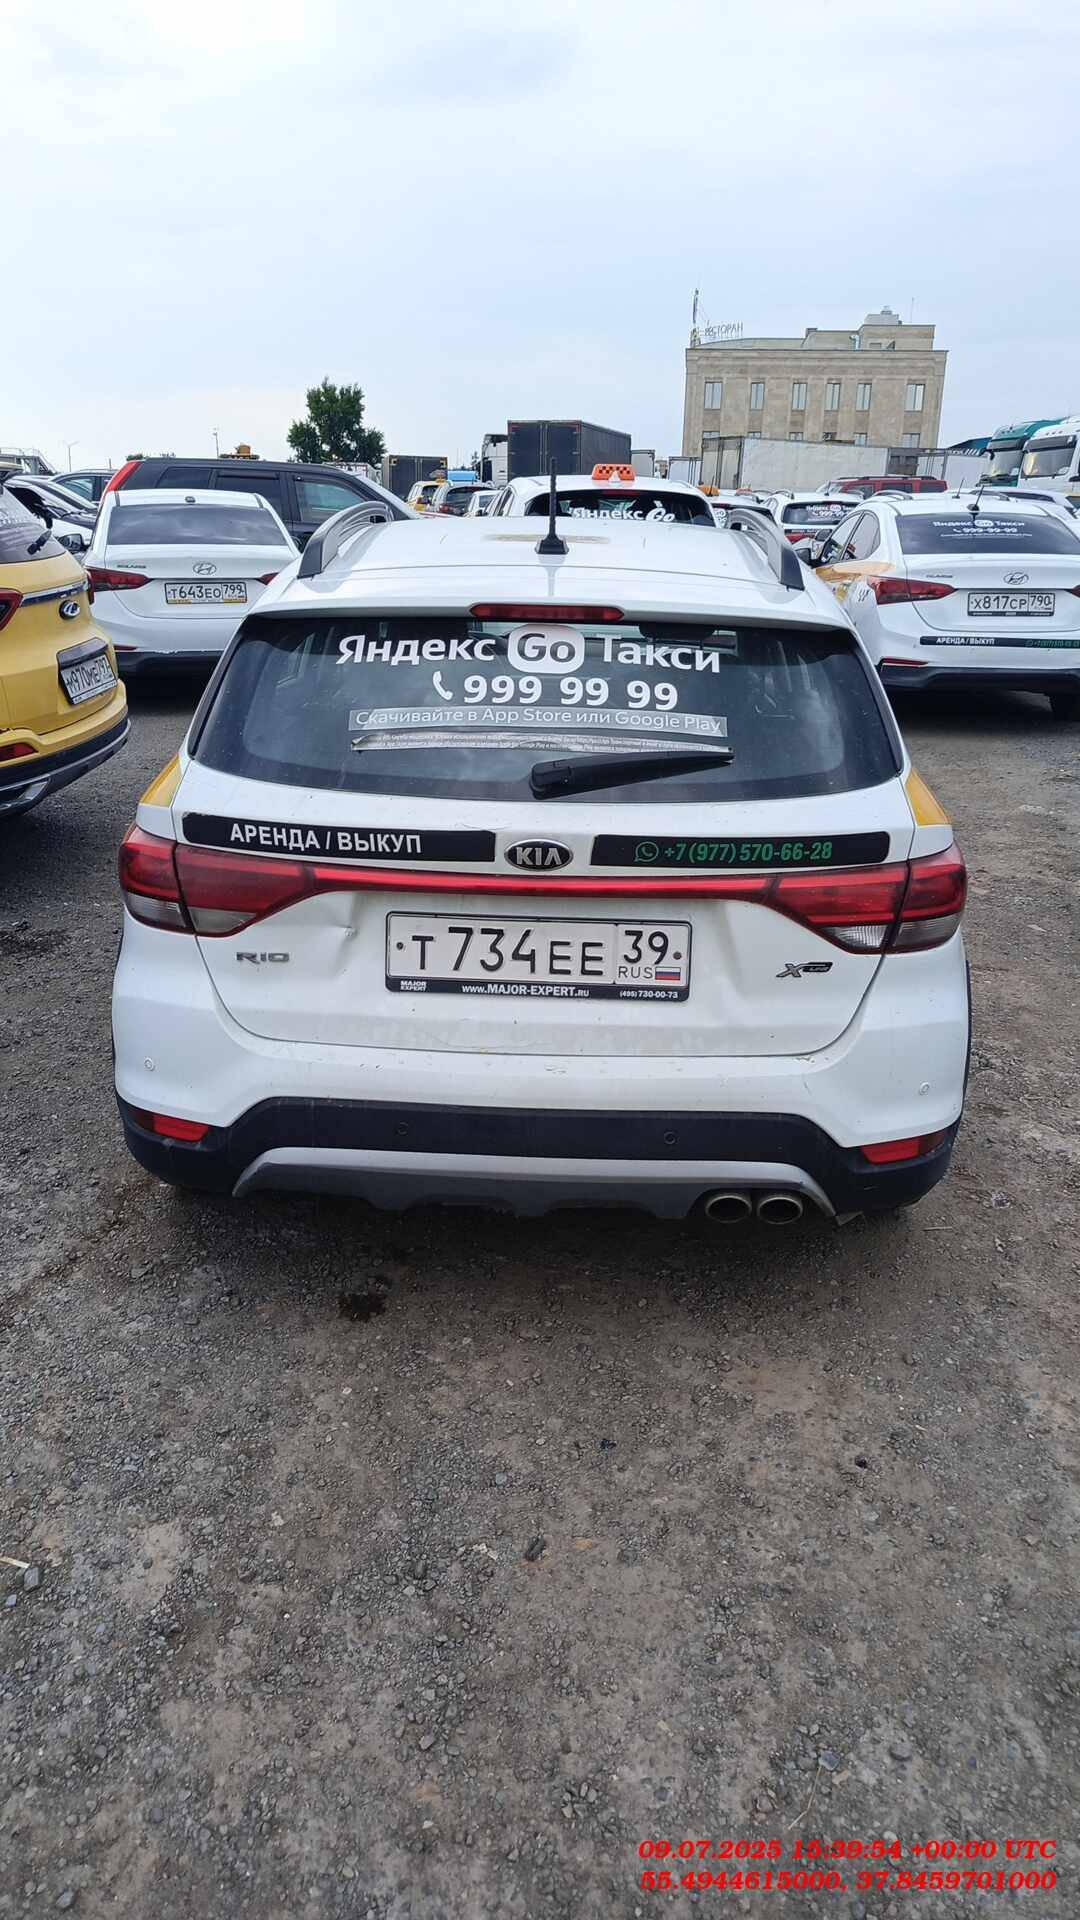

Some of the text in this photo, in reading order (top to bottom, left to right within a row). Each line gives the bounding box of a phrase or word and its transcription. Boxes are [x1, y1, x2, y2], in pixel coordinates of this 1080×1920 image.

[336, 632, 720, 673] Яндекс Go Такси
[464, 675, 678, 711] 999 99 99
[356, 708, 721, 732] Скачивайте в App Store или Google Play
[230, 823, 320, 851] АРЕНДА
[337, 831, 422, 853] ВЫКУП
[516, 847, 561, 865] KIA
[236, 952, 289, 965] RIO
[623, 930, 670, 965] 39
[618, 966, 653, 978] RUS
